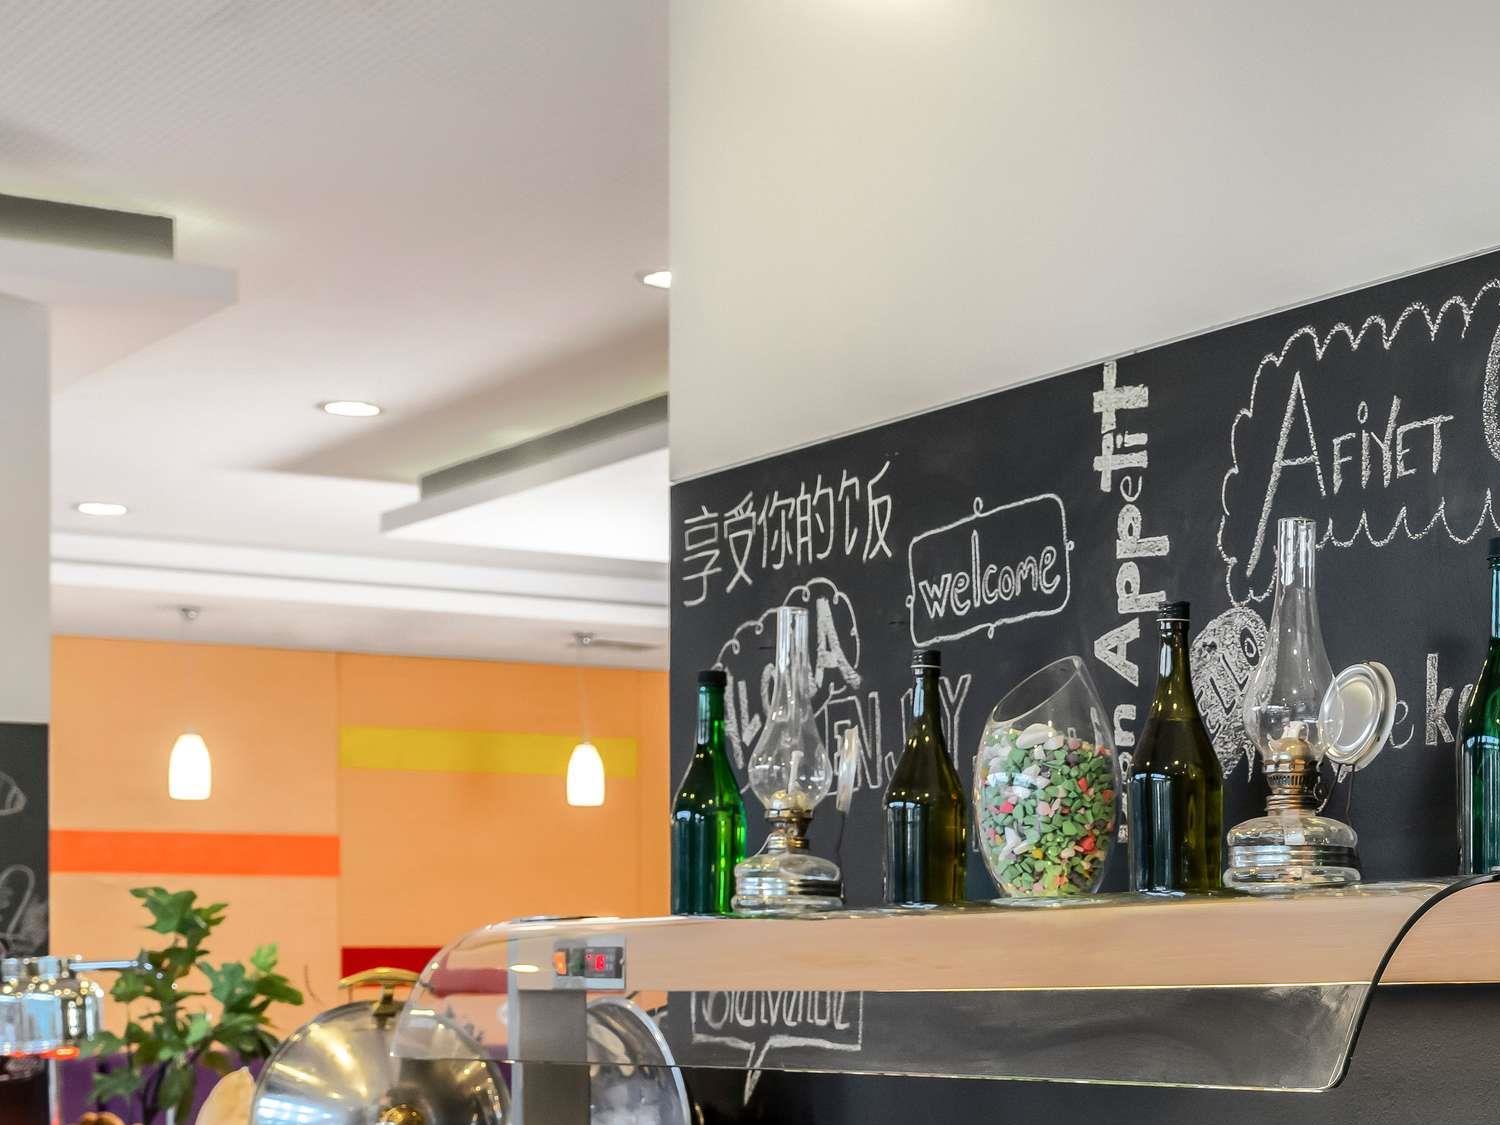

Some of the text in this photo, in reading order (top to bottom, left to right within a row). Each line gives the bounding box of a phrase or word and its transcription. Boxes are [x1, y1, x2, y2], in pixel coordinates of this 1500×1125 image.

[682, 461, 893, 607] 享受你的饭
[919, 529, 1062, 620] welcome
